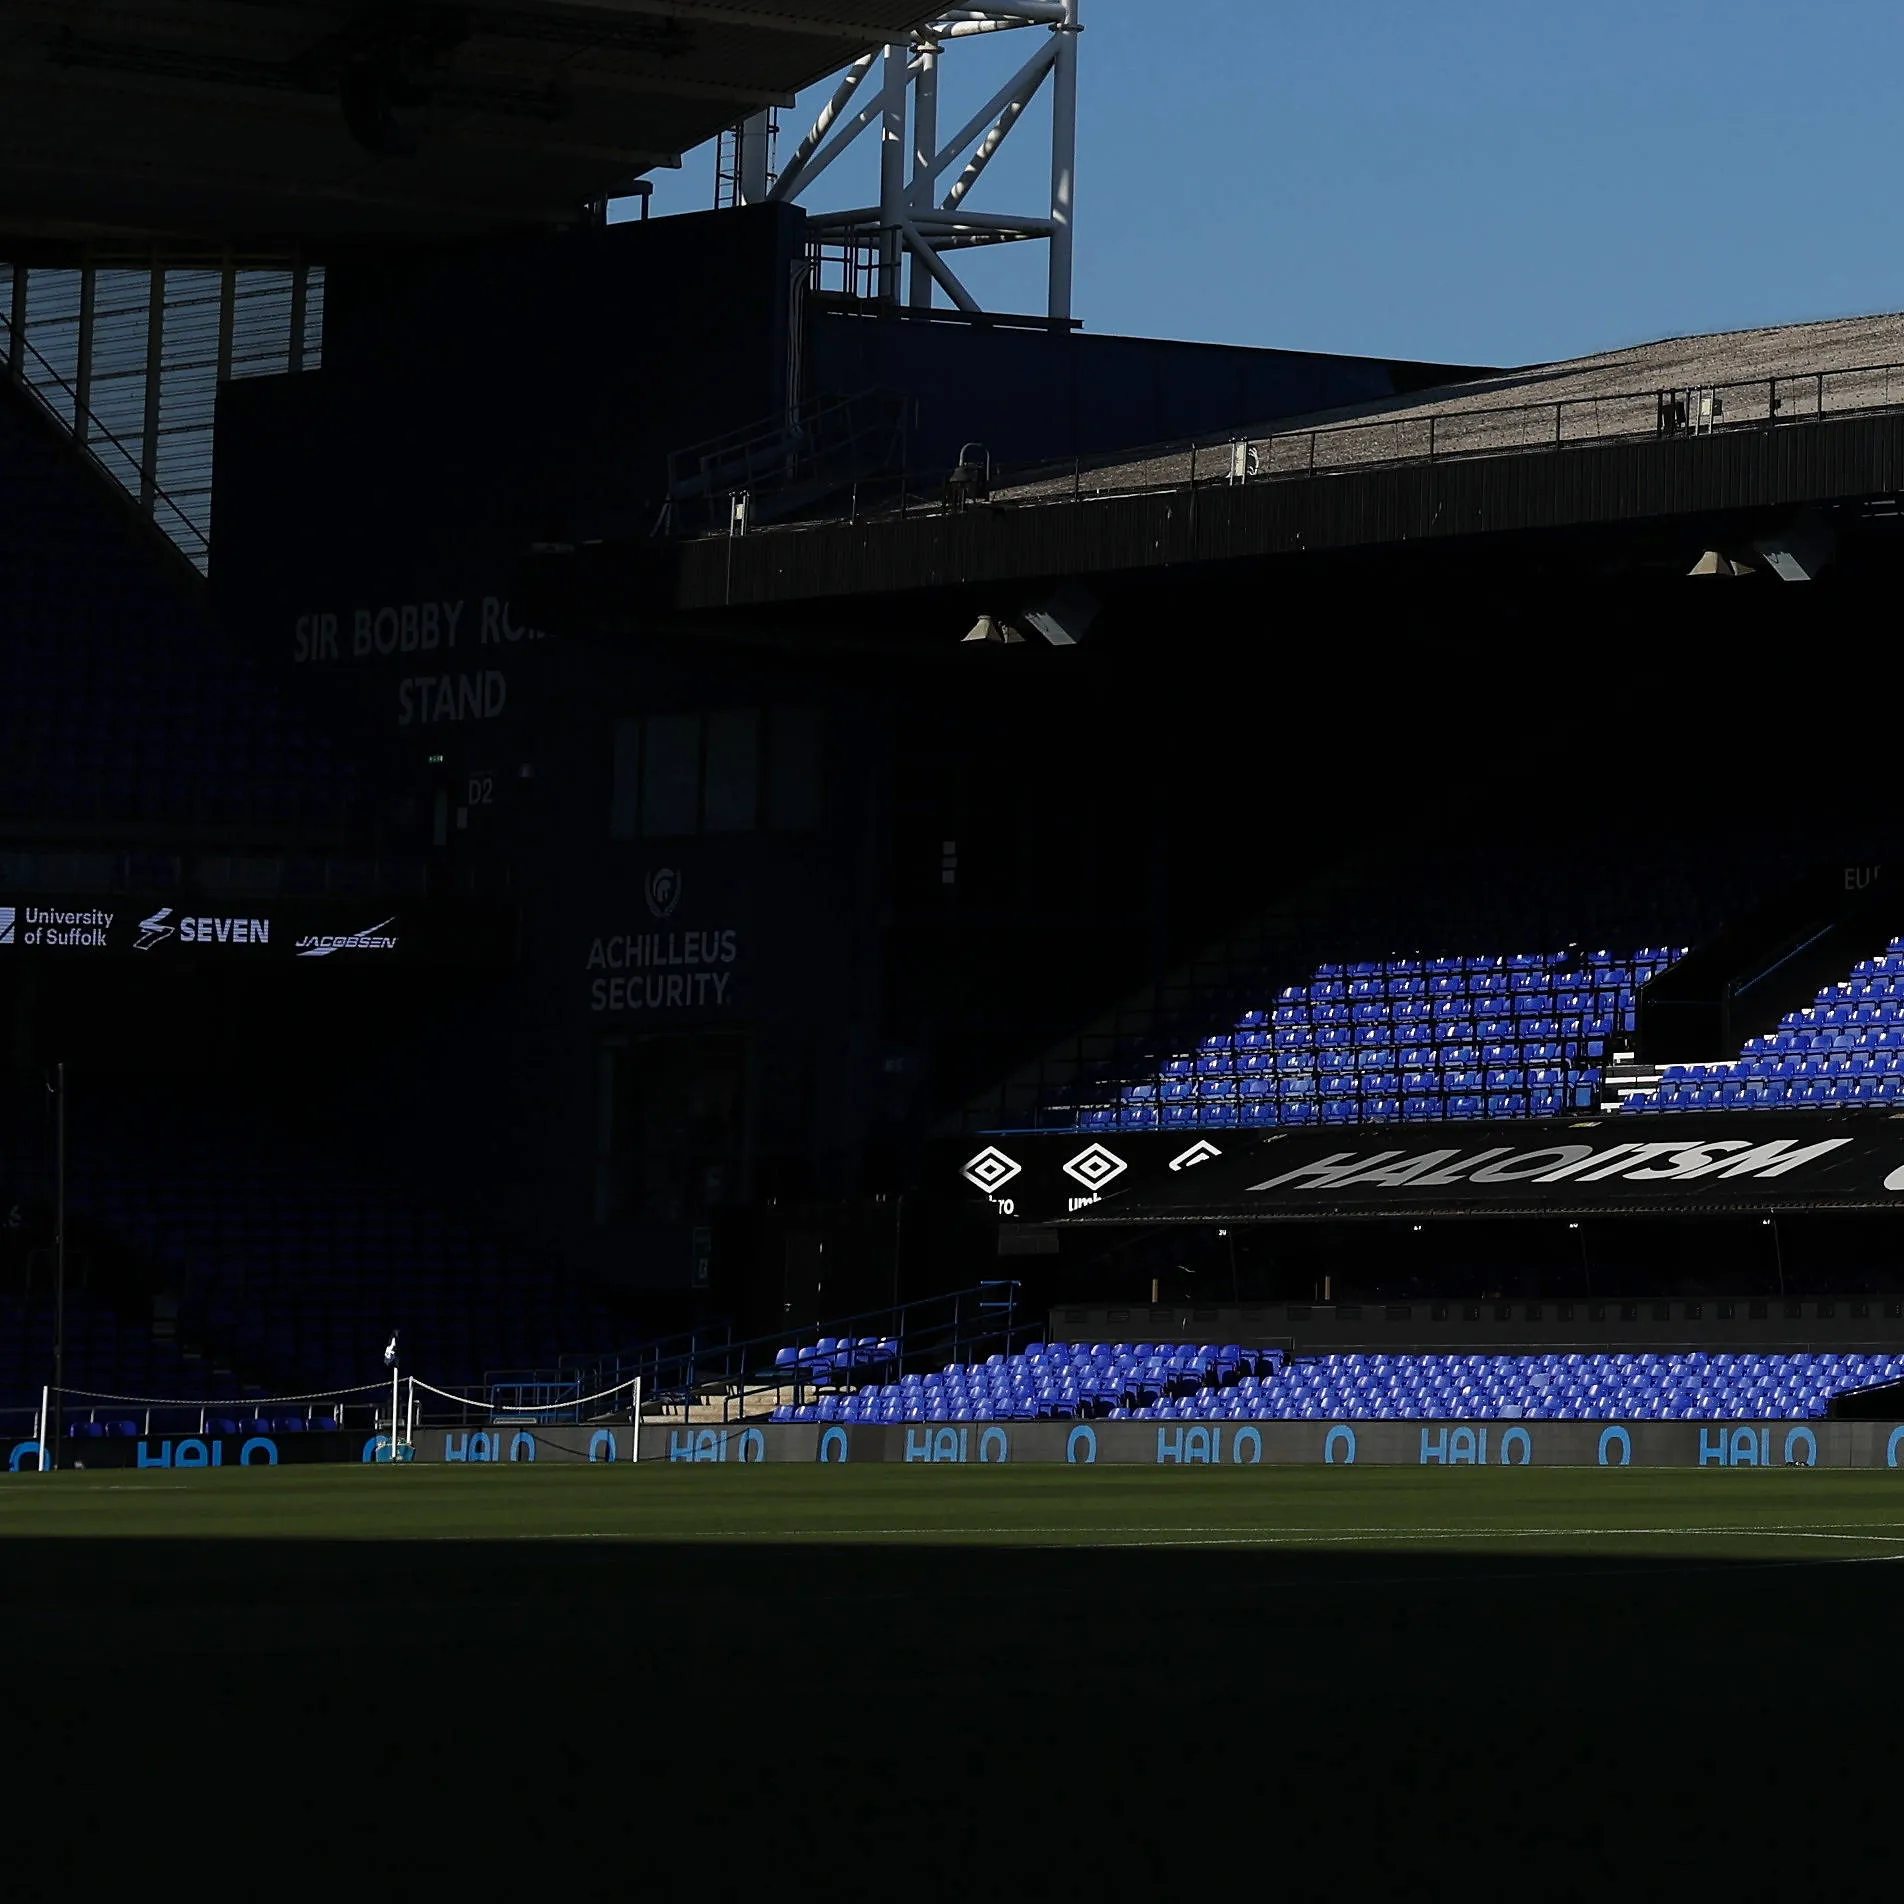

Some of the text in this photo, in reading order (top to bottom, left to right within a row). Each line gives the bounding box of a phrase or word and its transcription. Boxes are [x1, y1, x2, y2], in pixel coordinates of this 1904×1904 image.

[293, 613, 339, 663] SIR
[352, 599, 465, 658] BOBBY
[397, 670, 508, 727] STAND
[468, 778, 494, 805] D2
[24, 906, 114, 931] University
[24, 926, 108, 946] of Suffolk
[180, 916, 270, 945] SEVEN
[295, 934, 398, 950] JACOBSEN
[585, 928, 738, 971] ACHILLEUS
[1245, 1137, 1854, 1191] HALOITSM
[137, 1437, 278, 1468] HALO
[445, 1431, 537, 1462] HALO
[670, 1428, 765, 1461] HALO
[906, 1427, 1008, 1463] HALO
[1157, 1426, 1262, 1463] HALO
[1420, 1427, 1532, 1465] HALO
[1699, 1426, 1817, 1466] HALO
